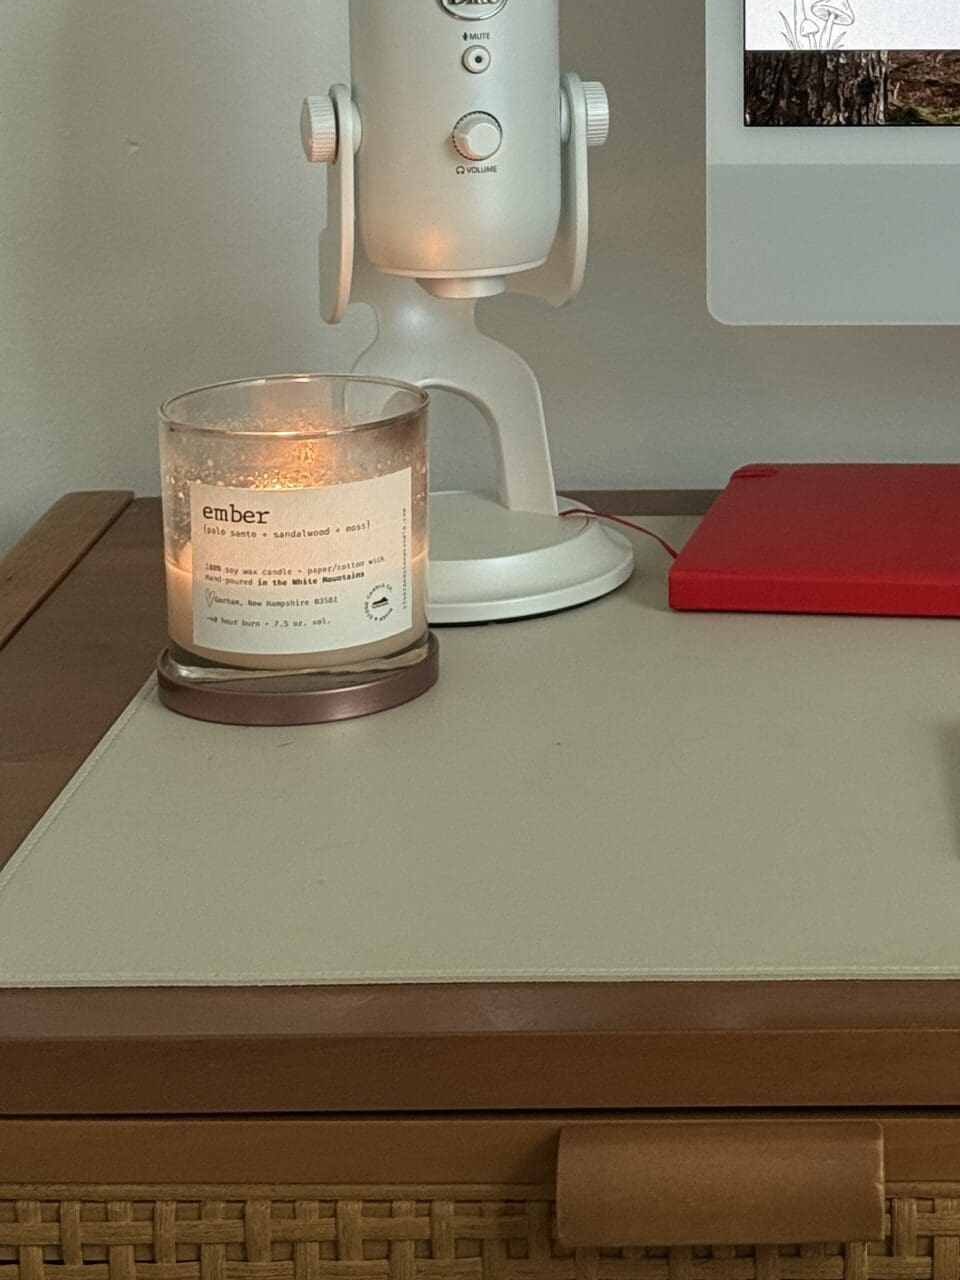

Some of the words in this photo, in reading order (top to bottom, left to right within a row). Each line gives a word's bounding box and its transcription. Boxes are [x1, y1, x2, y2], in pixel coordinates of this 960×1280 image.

[469, 32, 491, 40] MUTE
[466, 165, 498, 174] VOLUME
[203, 504, 270, 524] ember
[230, 530, 257, 538] santo
[273, 527, 330, 539] sandalwood
[225, 567, 239, 575] soy
[308, 561, 365, 575] paper/cotton
[368, 556, 385, 565] wick
[205, 574, 253, 585] Hand-poured
[258, 578, 268, 586] in
[322, 571, 365, 583] Mountains
[247, 599, 262, 607] New
[266, 598, 310, 608] Hampshire
[220, 617, 238, 625] hour
[241, 619, 261, 627] burn
